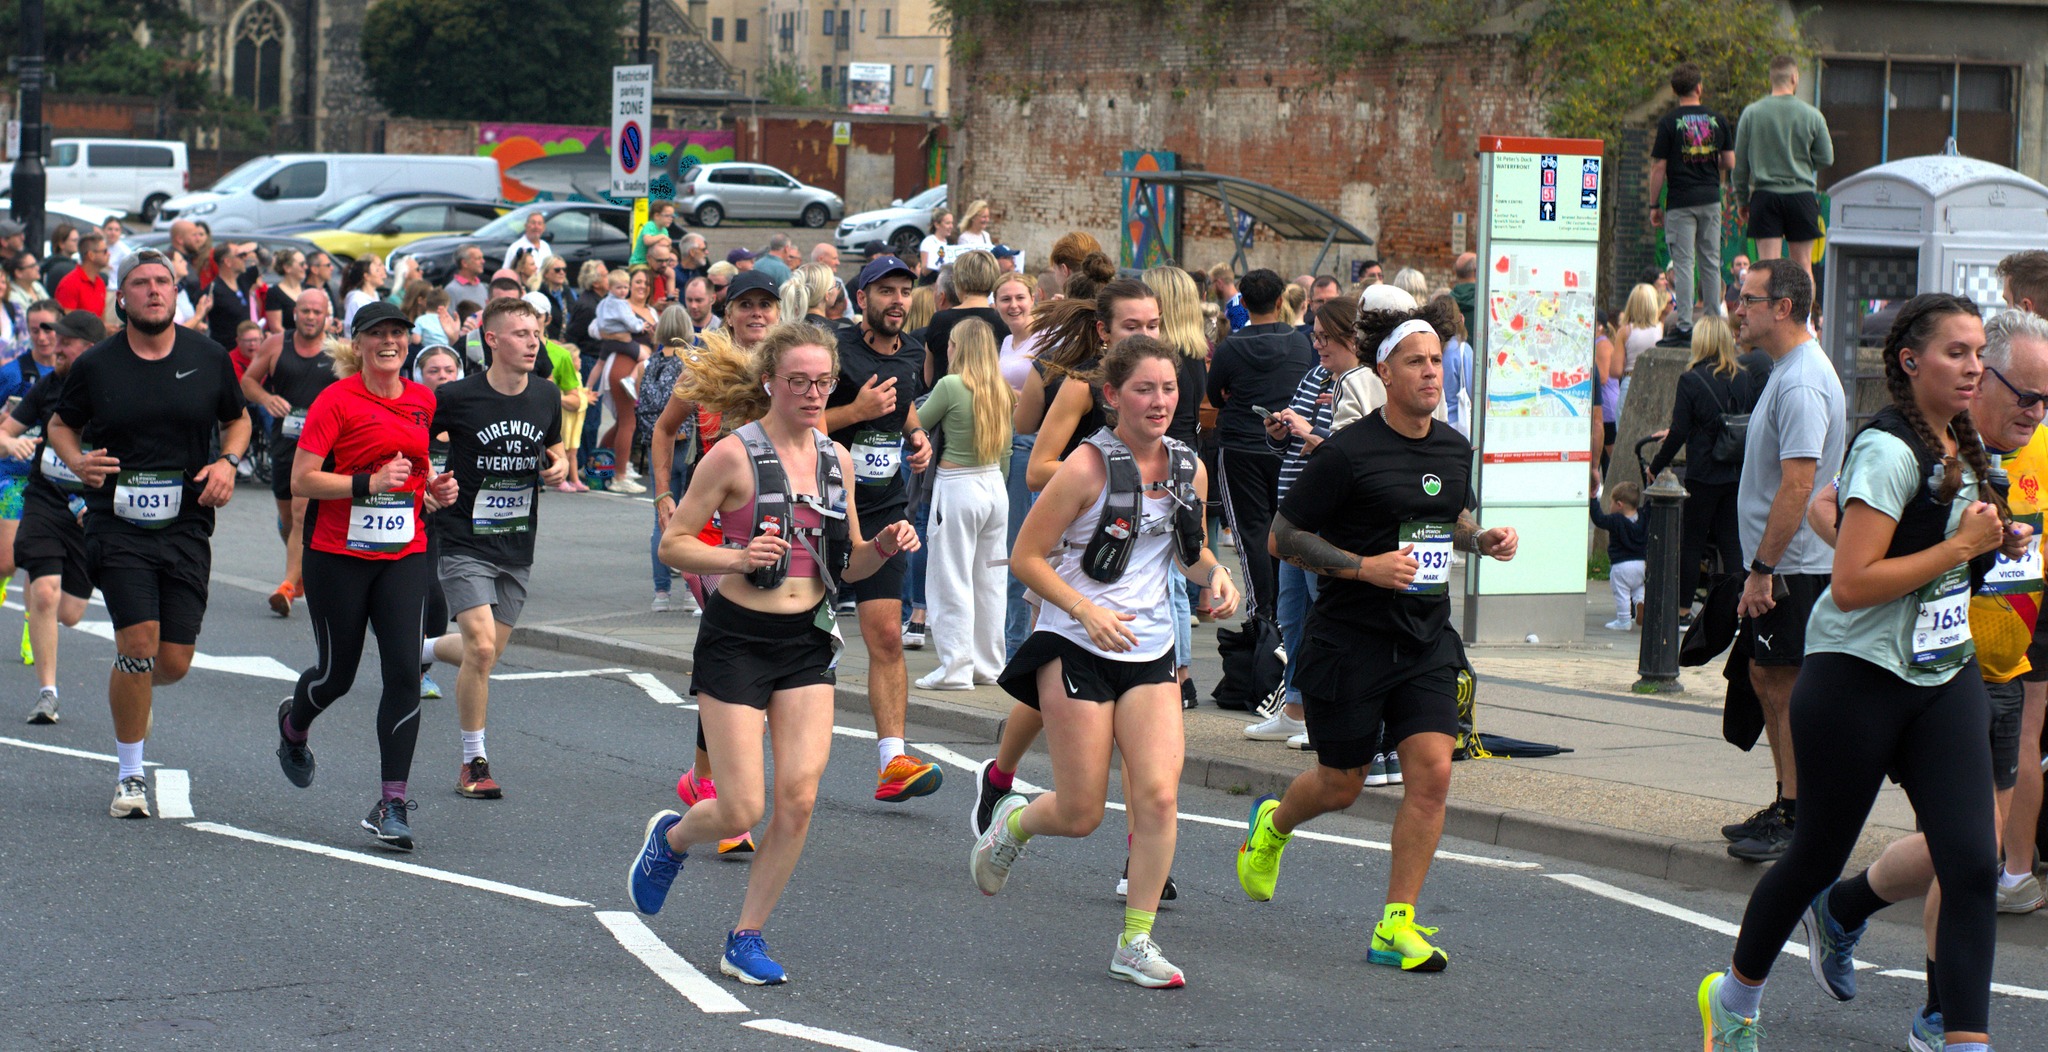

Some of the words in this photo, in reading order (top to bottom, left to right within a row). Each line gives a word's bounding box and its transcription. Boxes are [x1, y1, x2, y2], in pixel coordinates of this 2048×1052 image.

[616, 71, 649, 81] Restricted
[620, 85, 644, 98] parking
[620, 101, 643, 115] ZONE
[624, 181, 646, 192] loading
[1586, 176, 1596, 187] 51
[1543, 189, 1554, 200] 51
[476, 419, 544, 446] DIREWOLF
[505, 440, 522, 454] VS
[865, 453, 890, 467] 965
[128, 494, 169, 508] 1031
[486, 495, 524, 508] 2083
[362, 514, 405, 530] 2169
[1413, 551, 1449, 569] 1937
[1998, 570, 2025, 578] VICTOR
[1939, 633, 1960, 645] SOPHIE
